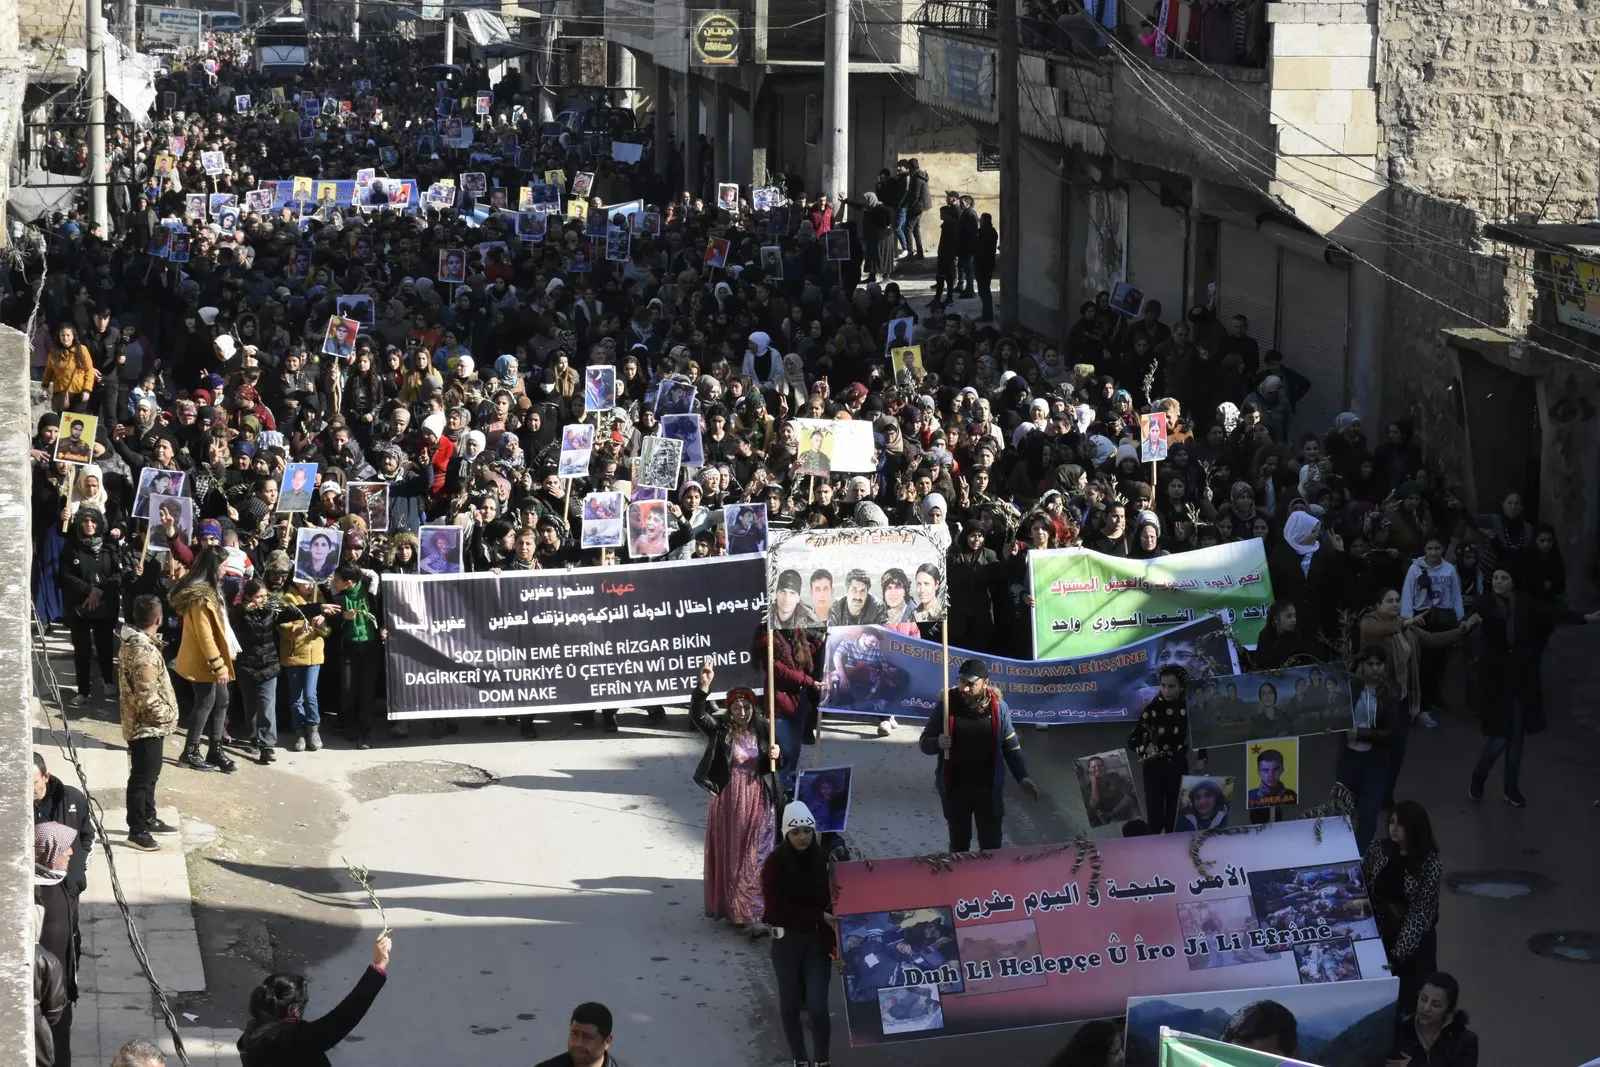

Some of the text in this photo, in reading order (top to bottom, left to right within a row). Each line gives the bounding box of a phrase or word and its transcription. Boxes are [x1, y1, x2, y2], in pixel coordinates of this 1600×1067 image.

[1050, 578, 1098, 596] المشترك
[1104, 577, 1150, 593] والعيش
[1238, 571, 1261, 586] نعم
[520, 585, 554, 602] عفرين
[558, 583, 594, 600] سنحرر
[632, 602, 671, 621] الدولة
[716, 598, 749, 615] يدوم
[431, 616, 466, 634] عفرين
[488, 611, 529, 631] لعفرين
[1052, 617, 1081, 634] واحد
[1092, 612, 1142, 634] السوري
[1146, 608, 1194, 626] الشعب
[455, 649, 483, 663] SOZ
[531, 644, 560, 660] EMÊ
[564, 641, 613, 659] EFRÎNÊ
[483, 670, 501, 682] YA
[566, 663, 576, 678] Û
[580, 660, 643, 680] ÇETEYÊN
[646, 658, 665, 673] WÎ
[740, 651, 751, 664] D
[1006, 665, 1076, 678] ROJAVA
[479, 686, 557, 702] DOM NAKE
[591, 676, 698, 697] EFRÎN YA ME YE
[1010, 681, 1097, 694] ERDOXAN
[1188, 863, 1247, 895] الأمس
[1106, 875, 1176, 903] حلبجة
[955, 890, 1014, 920] عفرين
[1023, 882, 1080, 916] اليوم
[903, 964, 960, 987] Duh
[964, 962, 993, 980] Li
[998, 953, 1101, 977] Helepçe
[1107, 933, 1127, 964] Û
[1135, 933, 1176, 962] Îro
[1215, 933, 1242, 953] Li
[1247, 917, 1332, 948] Efrînê
